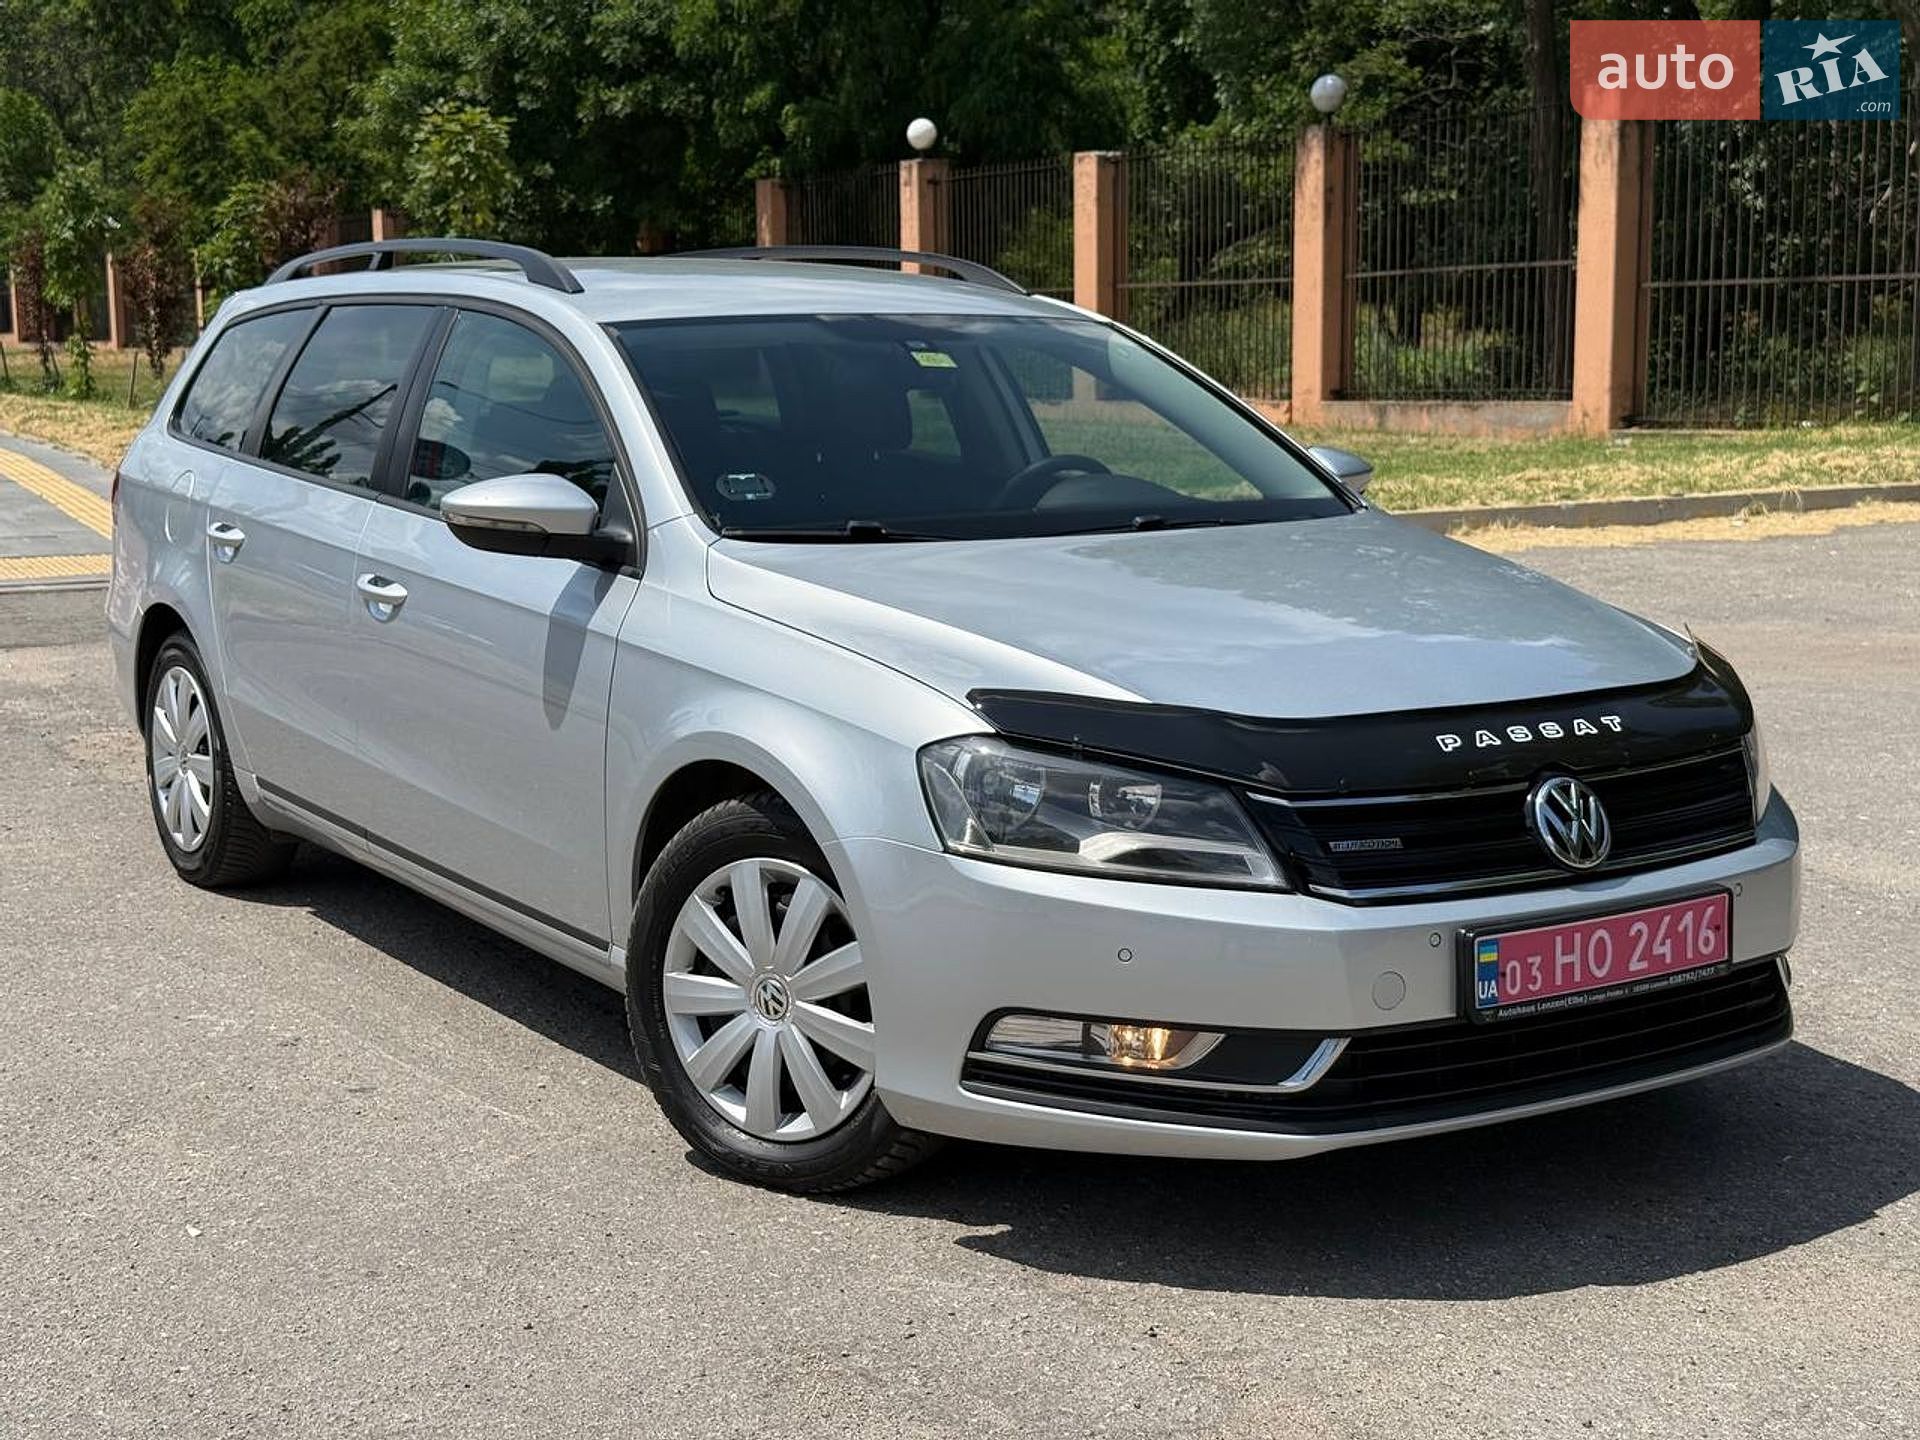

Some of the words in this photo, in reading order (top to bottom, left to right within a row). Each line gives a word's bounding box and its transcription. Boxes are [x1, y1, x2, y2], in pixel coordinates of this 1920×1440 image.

[1436, 715, 1622, 752] PASSAT
[1506, 955, 1542, 995] 03
[1554, 928, 1612, 985] HO
[1628, 905, 1716, 972] 2416
[1478, 980, 1499, 999] UA
